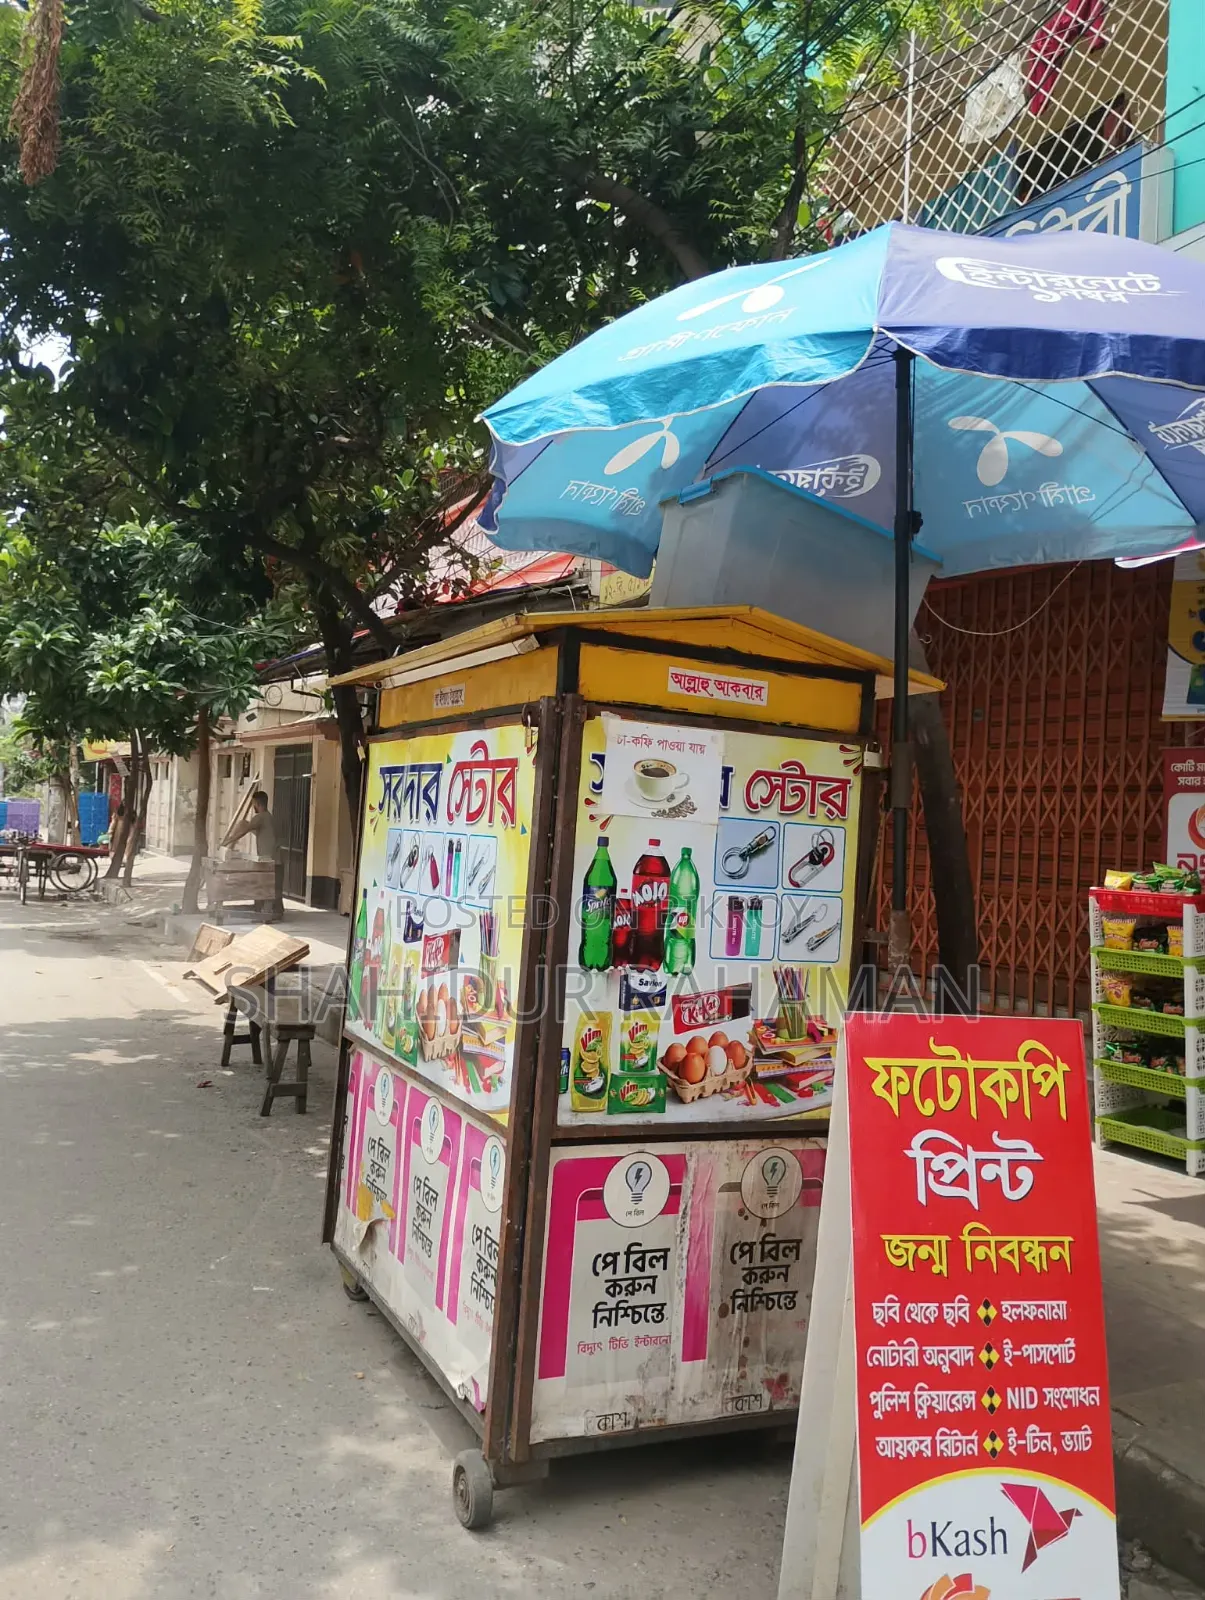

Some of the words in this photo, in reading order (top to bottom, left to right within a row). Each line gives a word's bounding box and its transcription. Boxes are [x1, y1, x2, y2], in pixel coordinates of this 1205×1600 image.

[962, 263, 1161, 293] ইন্টারনেটে
[671, 672, 714, 697] আল্লাহু
[714, 679, 765, 701] আকবার
[616, 733, 653, 749] চা-কফি
[657, 739, 686, 753] পাওয়া
[688, 742, 707, 755] যায়
[378, 761, 443, 824] সরদার
[446, 739, 519, 829] স্টোর
[743, 759, 852, 819] স্টোর
[863, 1036, 1071, 1122] ফটোকপি
[902, 1128, 1044, 1211] প্রিন্ট
[592, 1251, 620, 1277] পে
[624, 1242, 671, 1275] বিল
[730, 1240, 757, 1265] পে
[759, 1233, 803, 1263] বিল
[880, 1234, 953, 1278] জন্ম
[958, 1221, 1076, 1275] নিবন্ধন
[604, 1275, 658, 1298] করুন
[741, 1264, 791, 1286] করুন
[592, 1299, 668, 1328] নিশ্চিন্তে
[729, 1287, 799, 1315] নিশ্চিন্তে
[871, 1294, 900, 1327] ছবি
[904, 1301, 939, 1325] থেকে
[942, 1294, 970, 1327] ছবি
[1001, 1300, 1067, 1325] হলফনামা
[866, 1337, 920, 1368] নোটারী
[922, 1345, 974, 1374] অনুবাদ
[1002, 1337, 1076, 1368] ই-পাসপোর্ট
[868, 1382, 910, 1420] পুলিশ
[913, 1381, 977, 1420] ক্লিয়ারেন্স
[1006, 1386, 1039, 1410] NID
[1042, 1386, 1100, 1411] সংশোধন
[875, 1435, 932, 1460] আয়কর
[935, 1427, 979, 1458] রিটার্ন
[1007, 1424, 1058, 1456] ই-টিন,
[1061, 1425, 1093, 1454] ভ্যাট
[906, 1516, 1009, 1560] bKash
